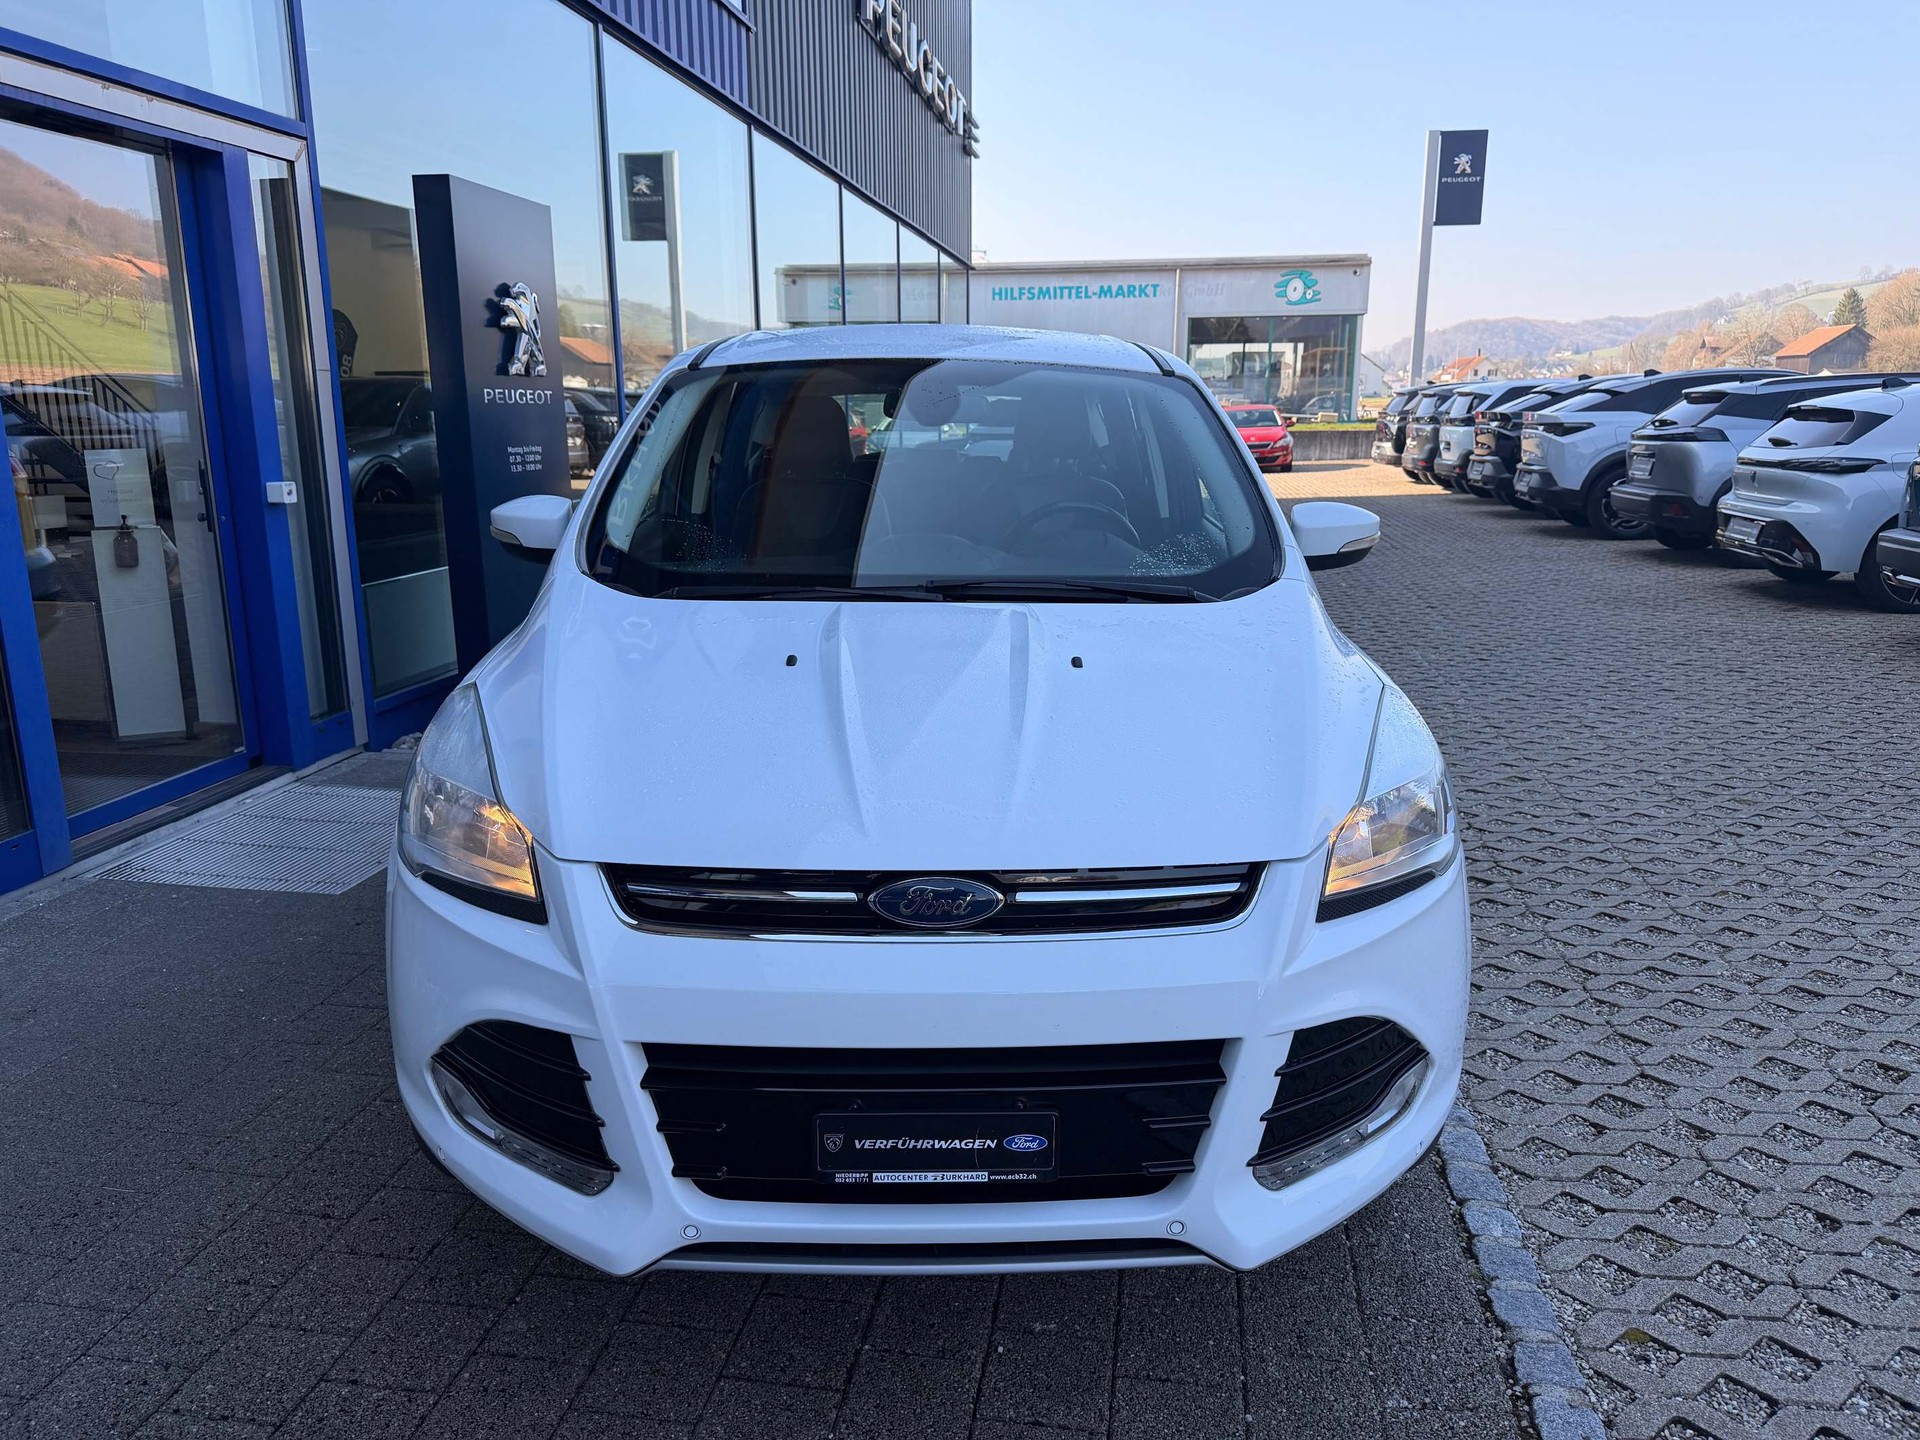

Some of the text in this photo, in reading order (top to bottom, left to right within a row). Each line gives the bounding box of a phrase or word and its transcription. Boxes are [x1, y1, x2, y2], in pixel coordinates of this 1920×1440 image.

[991, 283, 1160, 301] HILFSMITTEL-MARKT
[483, 388, 553, 405] PEUGEOT
[507, 446, 523, 455] Montag
[529, 444, 542, 453] Freitag
[900, 885, 972, 916] Ford
[854, 1137, 998, 1149] VERFÜHRWAGEN
[873, 1174, 929, 1182] AUTOCENTER
